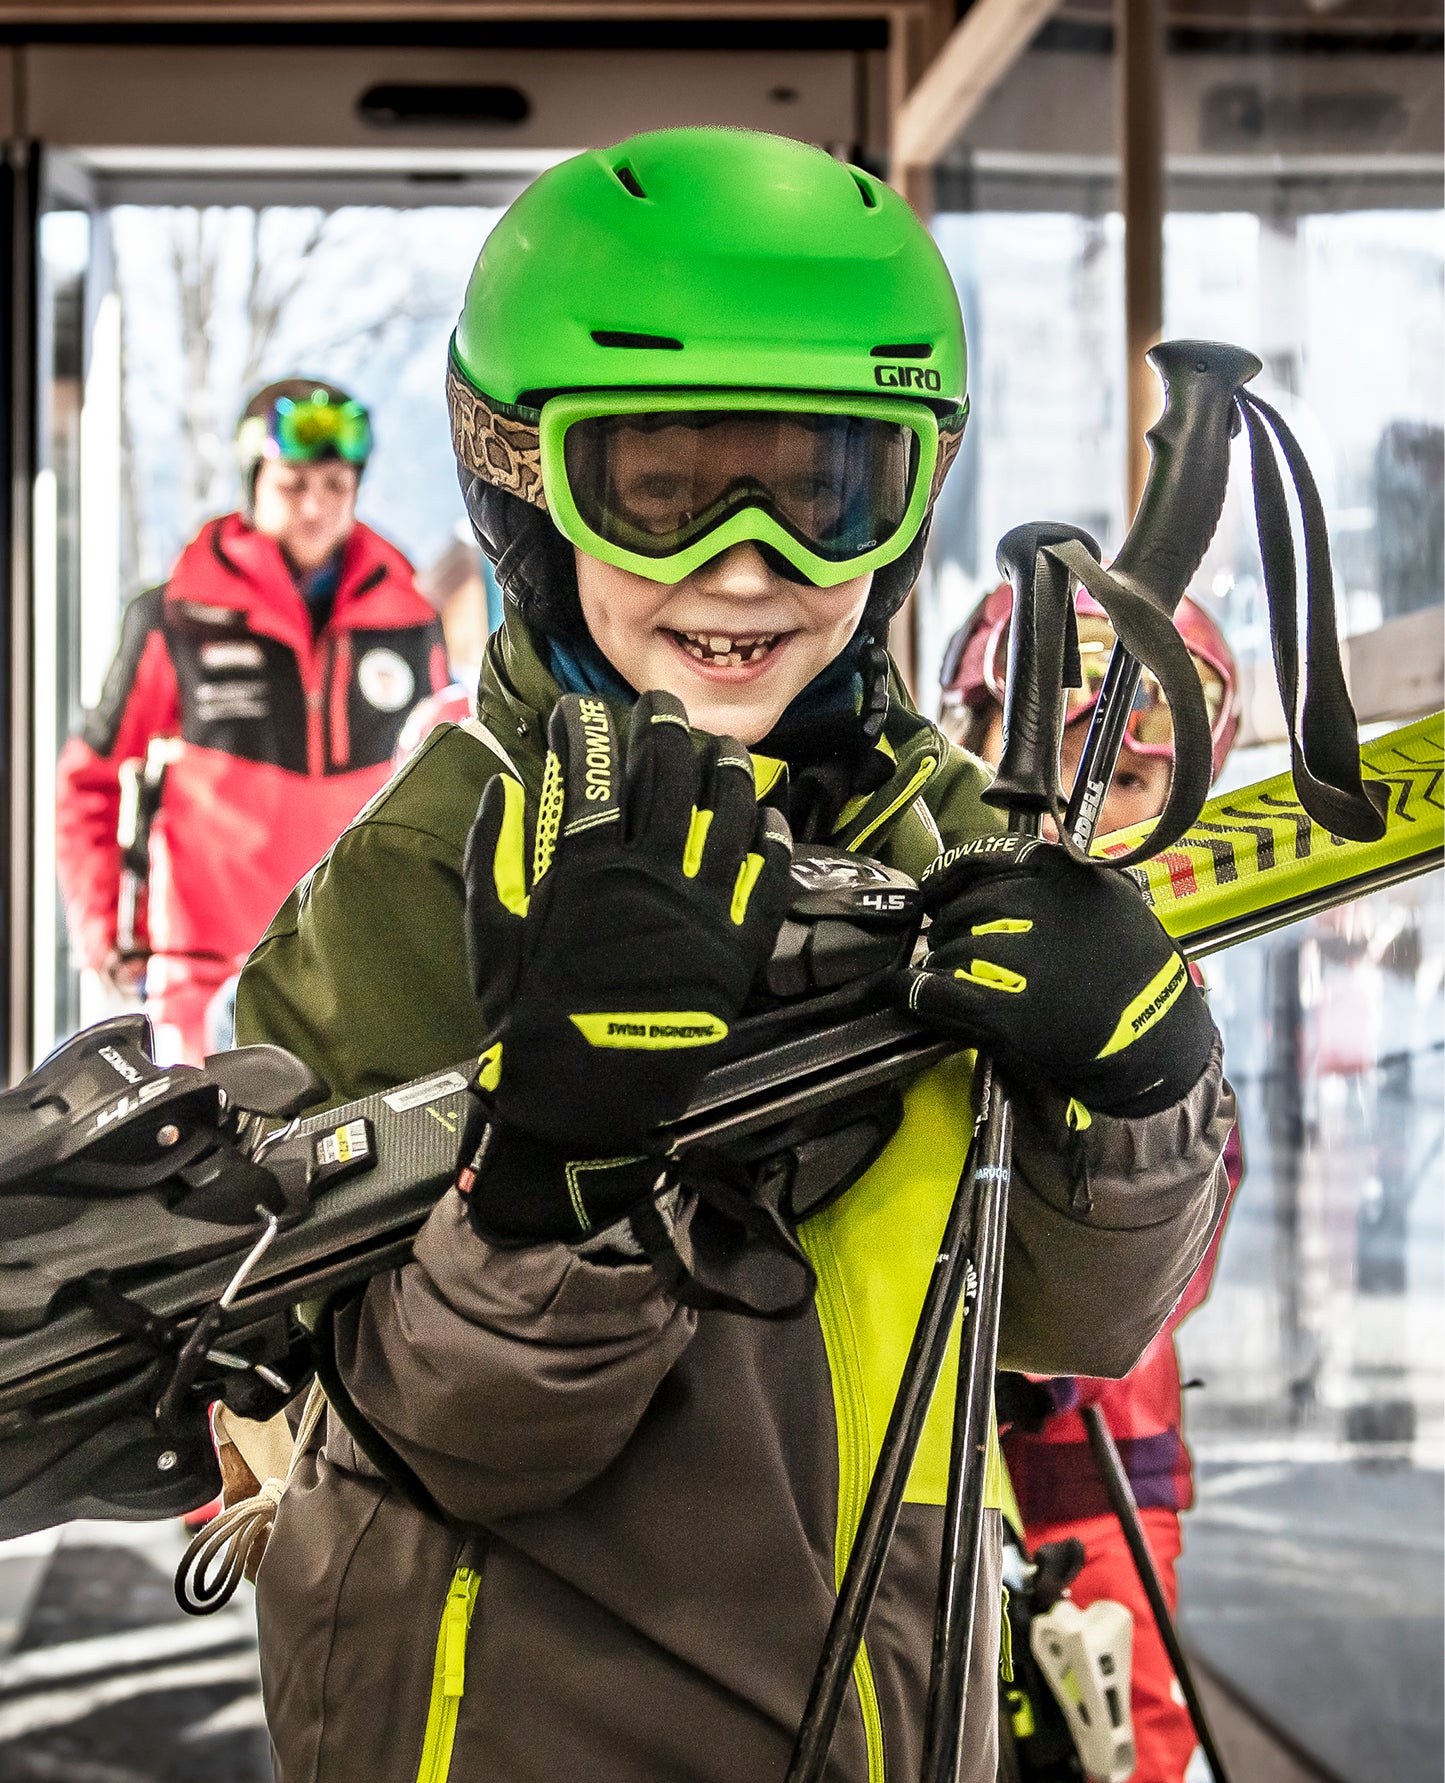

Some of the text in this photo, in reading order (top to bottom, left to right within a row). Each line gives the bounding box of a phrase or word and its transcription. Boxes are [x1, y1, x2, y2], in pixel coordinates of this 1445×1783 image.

[874, 365, 941, 392] GIRO
[579, 698, 611, 802] SNOWLIFE
[921, 836, 1020, 882] SNOWLIFE
[862, 895, 906, 911] 4.5
